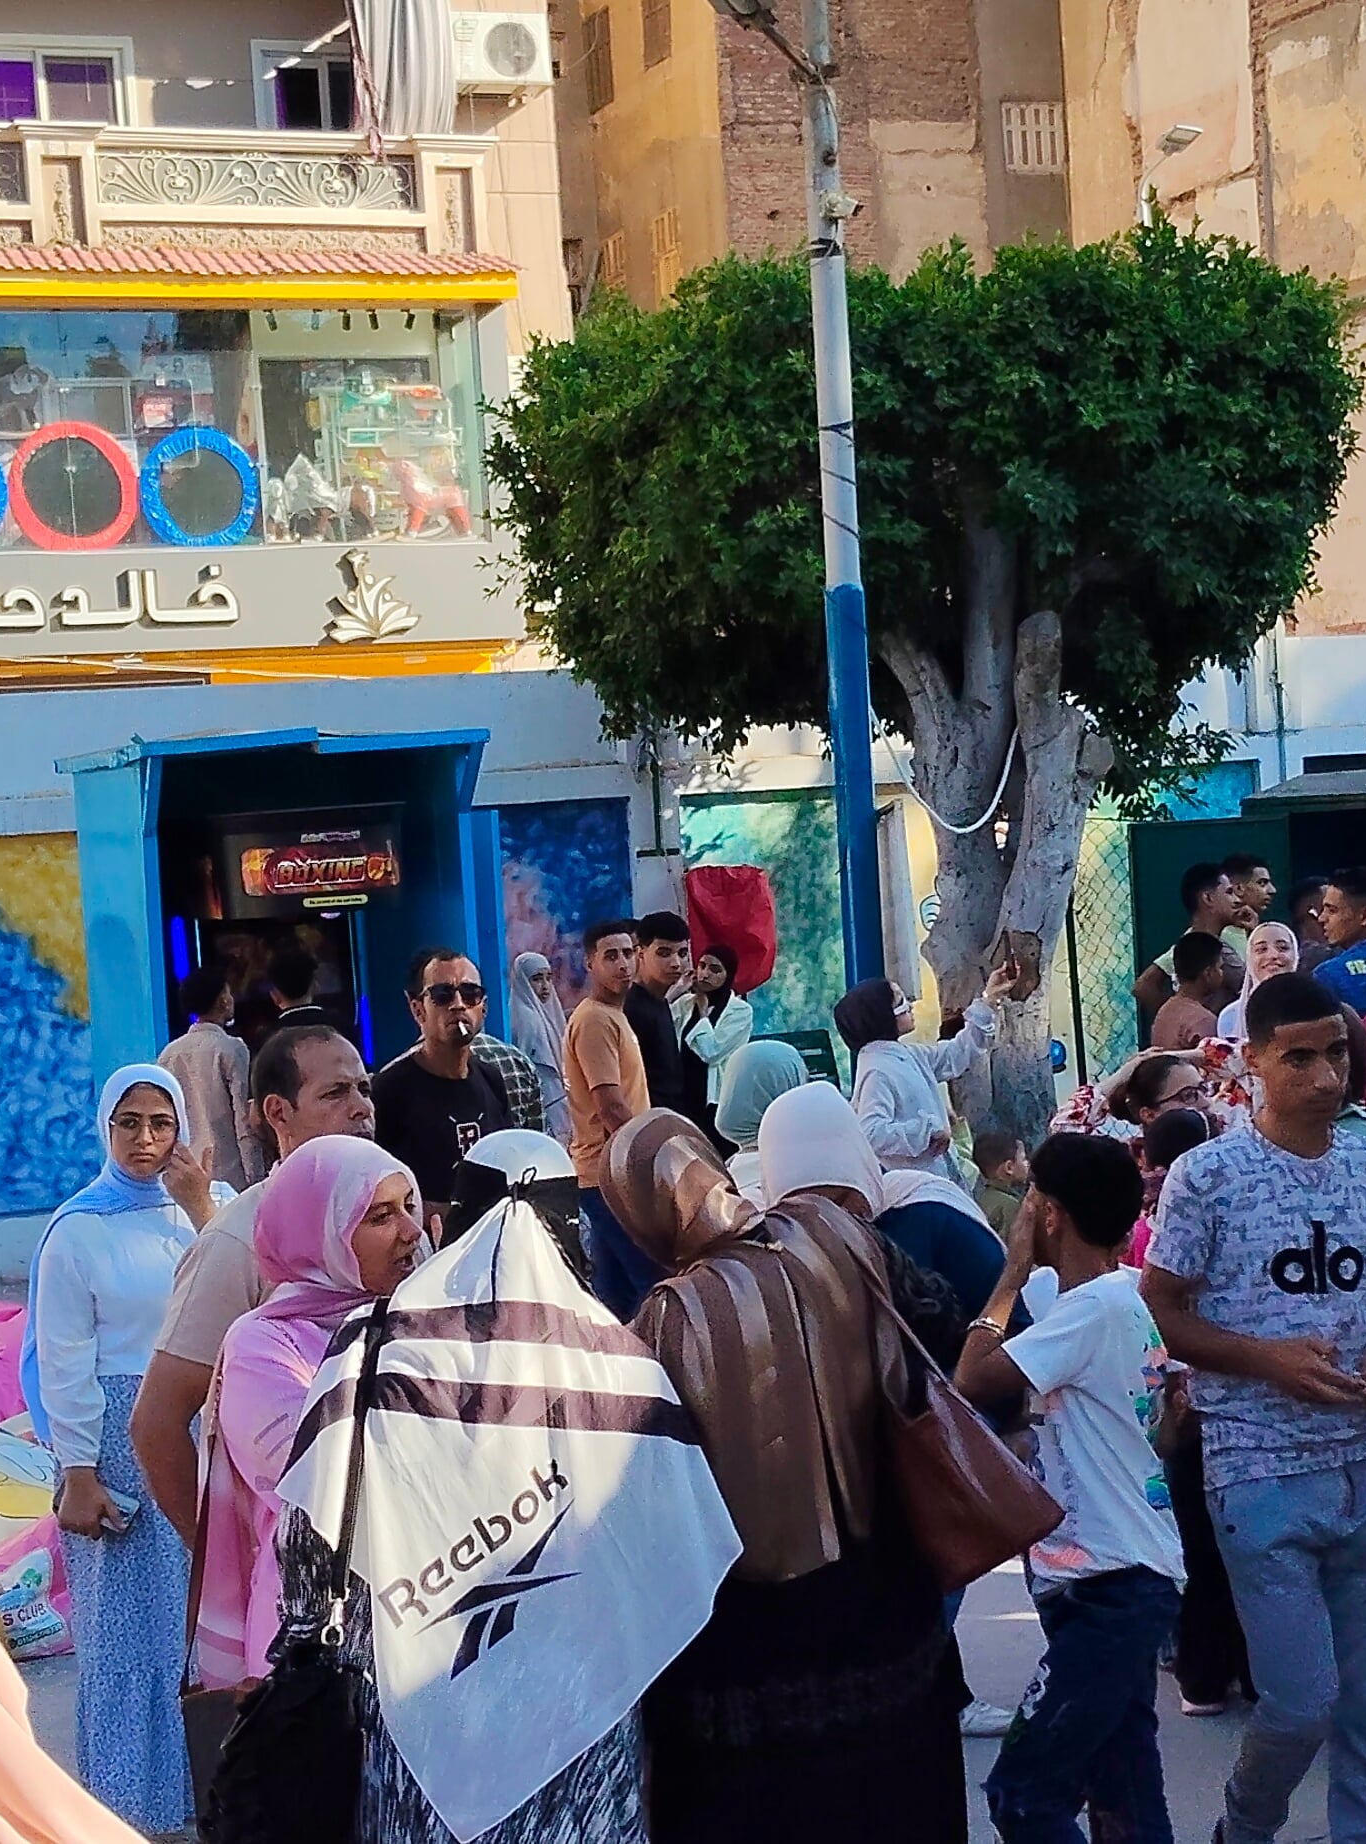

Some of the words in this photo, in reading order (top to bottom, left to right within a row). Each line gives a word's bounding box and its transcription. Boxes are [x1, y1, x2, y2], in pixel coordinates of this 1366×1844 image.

[60, 564, 240, 627] خالد
[276, 860, 364, 884] BOXING
[1270, 1219, 1365, 1295] alo
[376, 1457, 570, 1629] Reebok
[17, 1603, 47, 1622] CLUB
